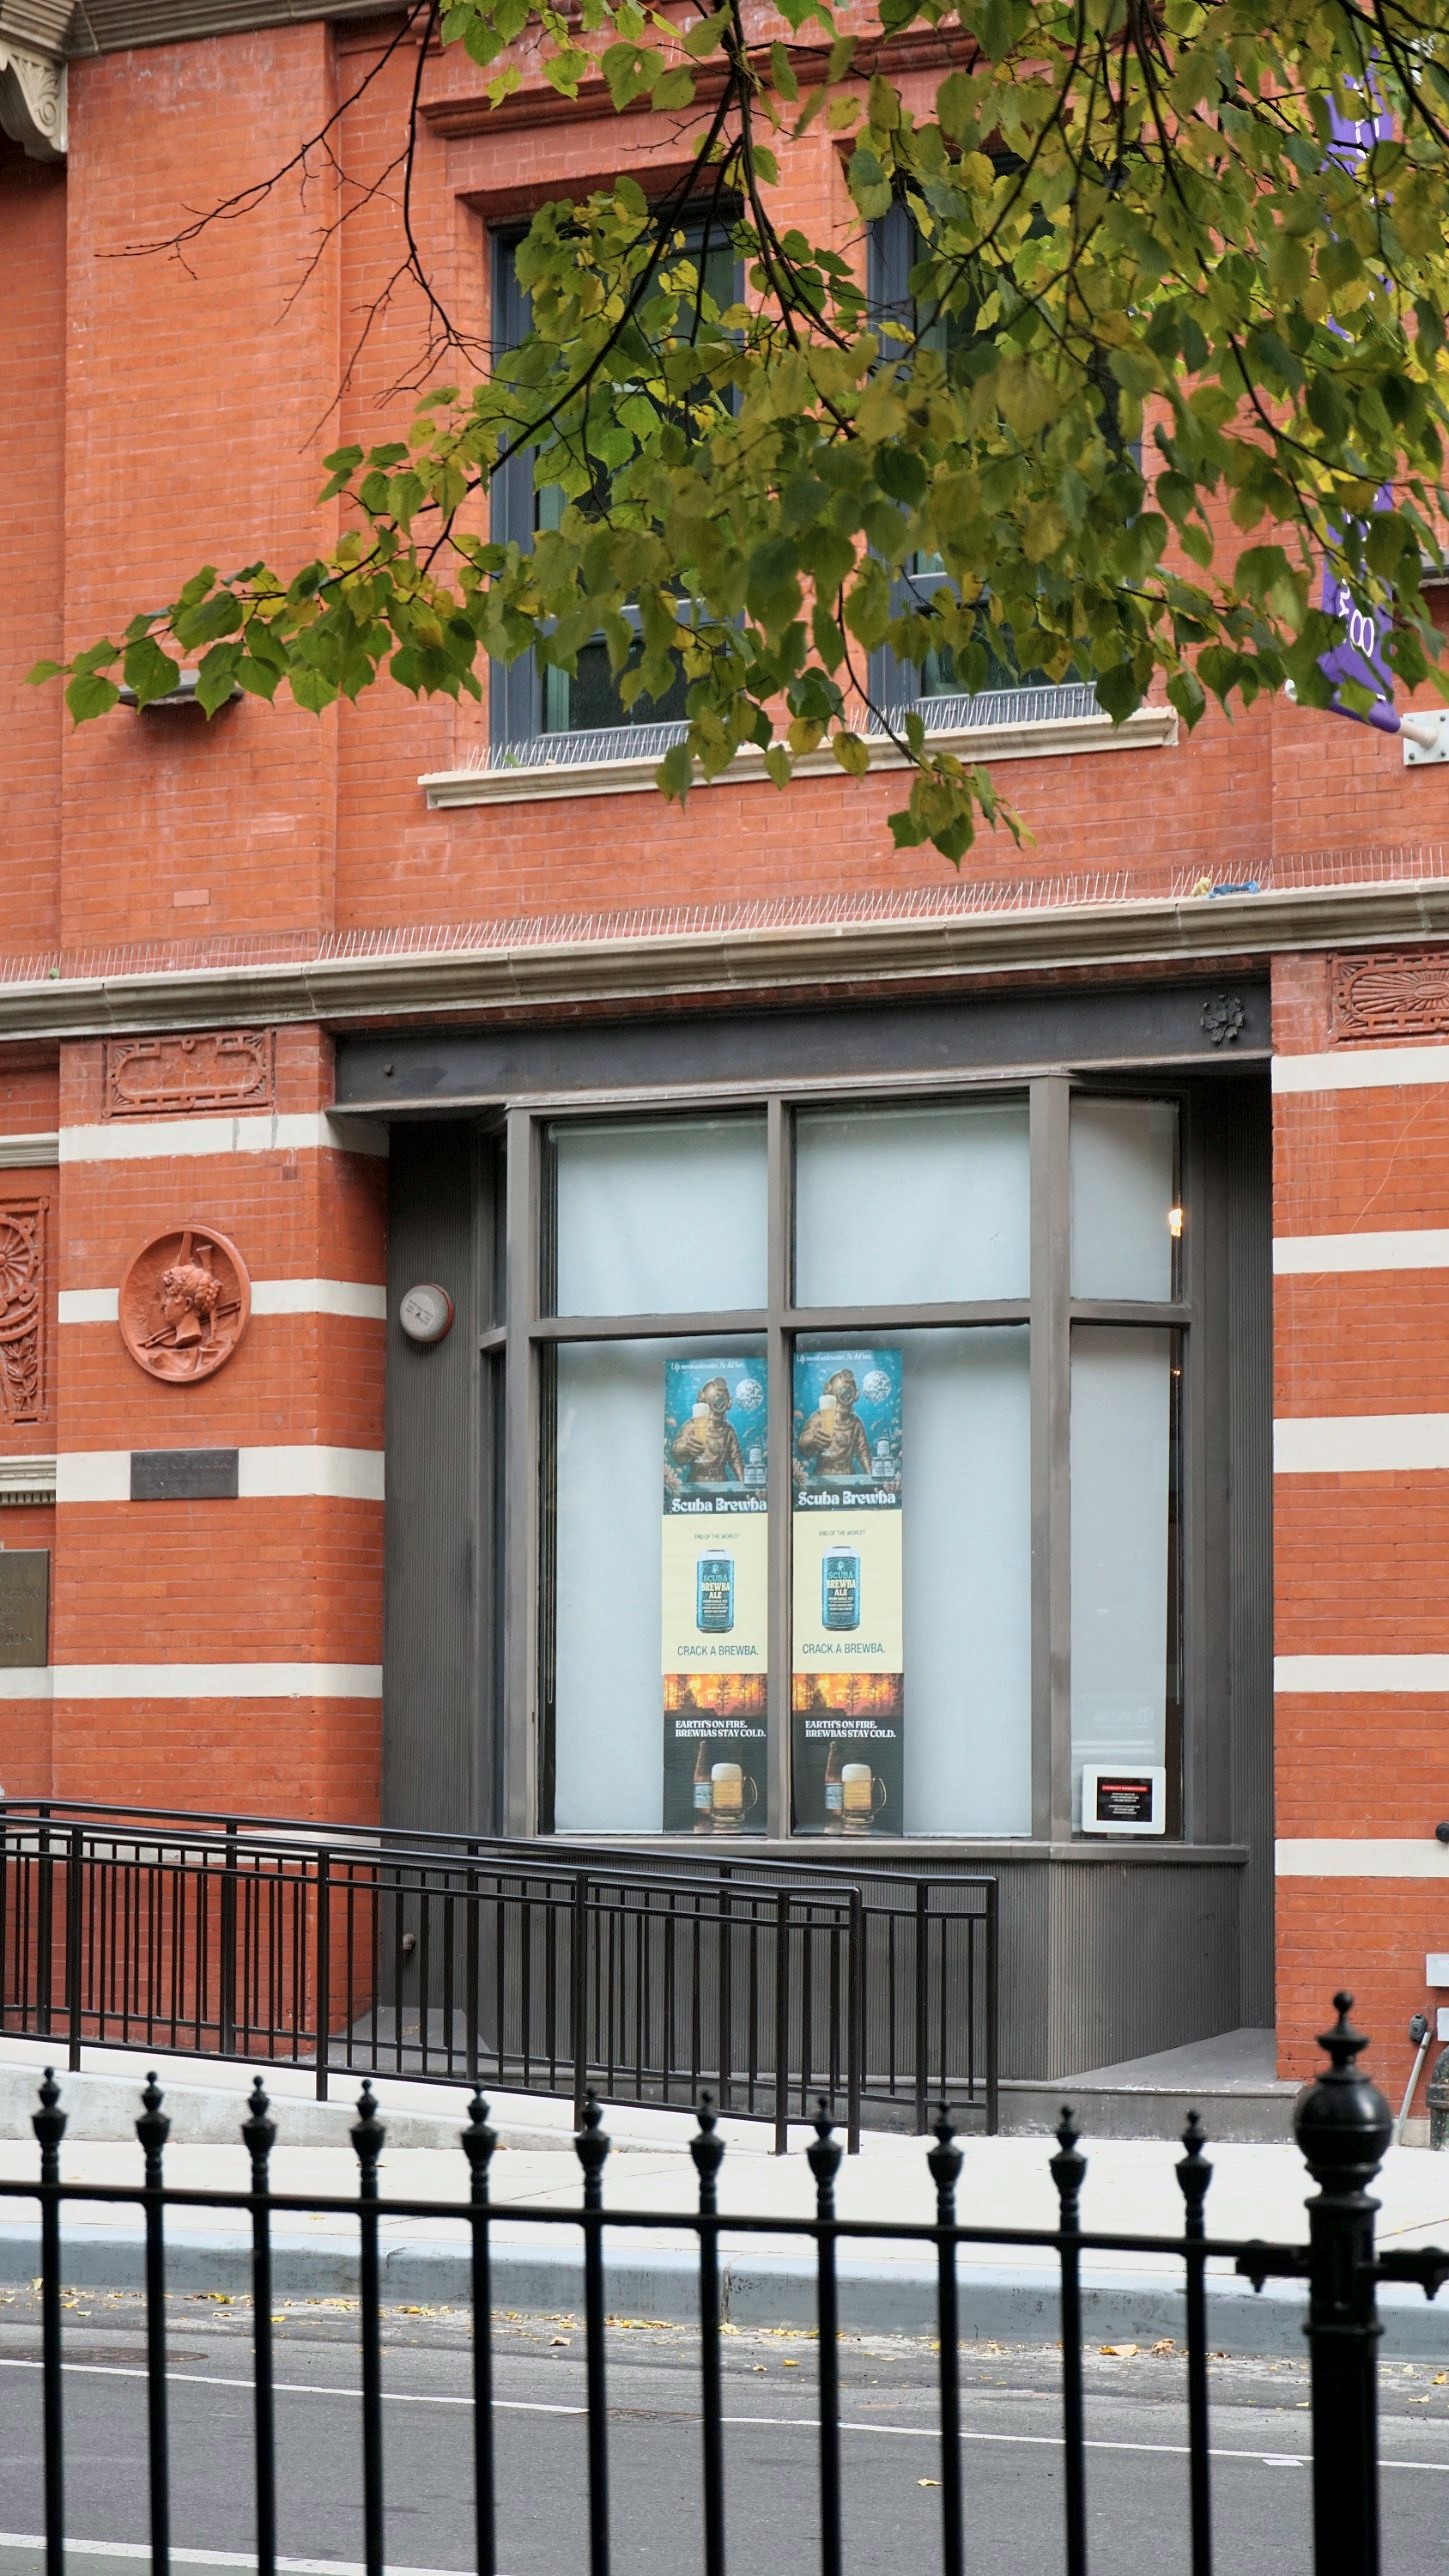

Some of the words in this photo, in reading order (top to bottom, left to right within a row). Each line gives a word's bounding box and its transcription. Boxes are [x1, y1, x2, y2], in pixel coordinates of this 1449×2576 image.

[798, 1490, 840, 1505] Scuba
[843, 1490, 896, 1505] Brewba
[672, 1497, 713, 1512] Scuba
[716, 1497, 767, 1512] Brewba
[703, 1574, 728, 1583] SCUBA
[828, 1571, 854, 1580] SCUBA
[701, 1582, 731, 1592] BREWBA
[826, 1579, 857, 1589] BREWBA
[708, 1591, 723, 1599] ALE
[834, 1588, 848, 1597] ALE
[677, 1645, 708, 1656] CRACK
[710, 1645, 717, 1656] A
[718, 1645, 759, 1656] BREWBA.
[802, 1643, 833, 1654] CRACK
[835, 1643, 842, 1654] A
[844, 1643, 885, 1654] BREWBA.
[675, 1720, 711, 1729] EARTH'S
[711, 1720, 725, 1729] ON
[725, 1720, 748, 1729] FIRE.
[805, 1720, 841, 1729] EARTH'S
[841, 1720, 855, 1729] ON
[855, 1720, 877, 1729] FIRE.
[675, 1729, 717, 1738] BREWBAS
[717, 1729, 739, 1738] STAY
[740, 1729, 766, 1738] COLD.
[805, 1729, 847, 1738] BREWBAS
[847, 1729, 869, 1738] STAY
[869, 1729, 896, 1738] COLD.
